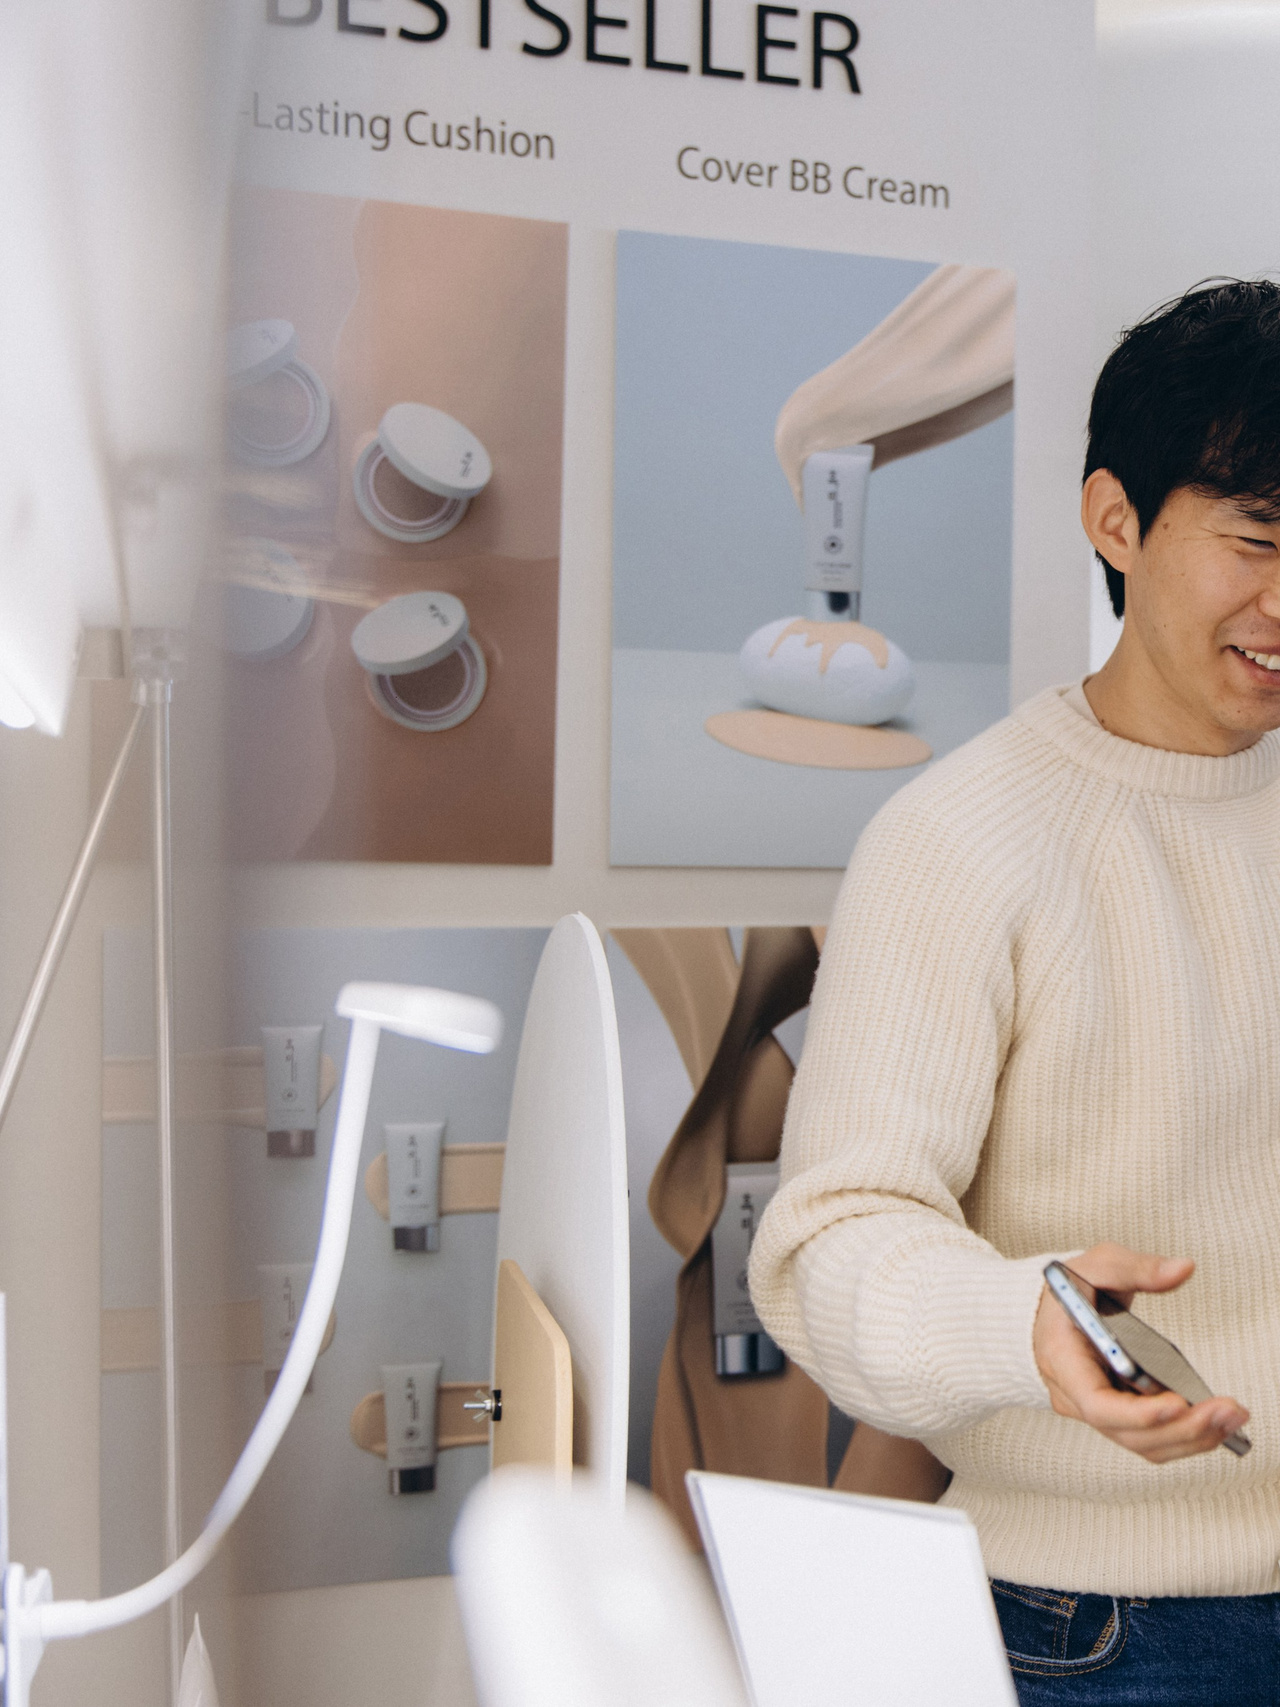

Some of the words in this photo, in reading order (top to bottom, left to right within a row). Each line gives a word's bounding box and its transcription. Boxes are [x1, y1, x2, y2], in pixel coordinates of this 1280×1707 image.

[405, 110, 556, 160] Cushion
[677, 146, 779, 189] Cover
[790, 159, 832, 195] BB
[843, 166, 951, 210] Cream
